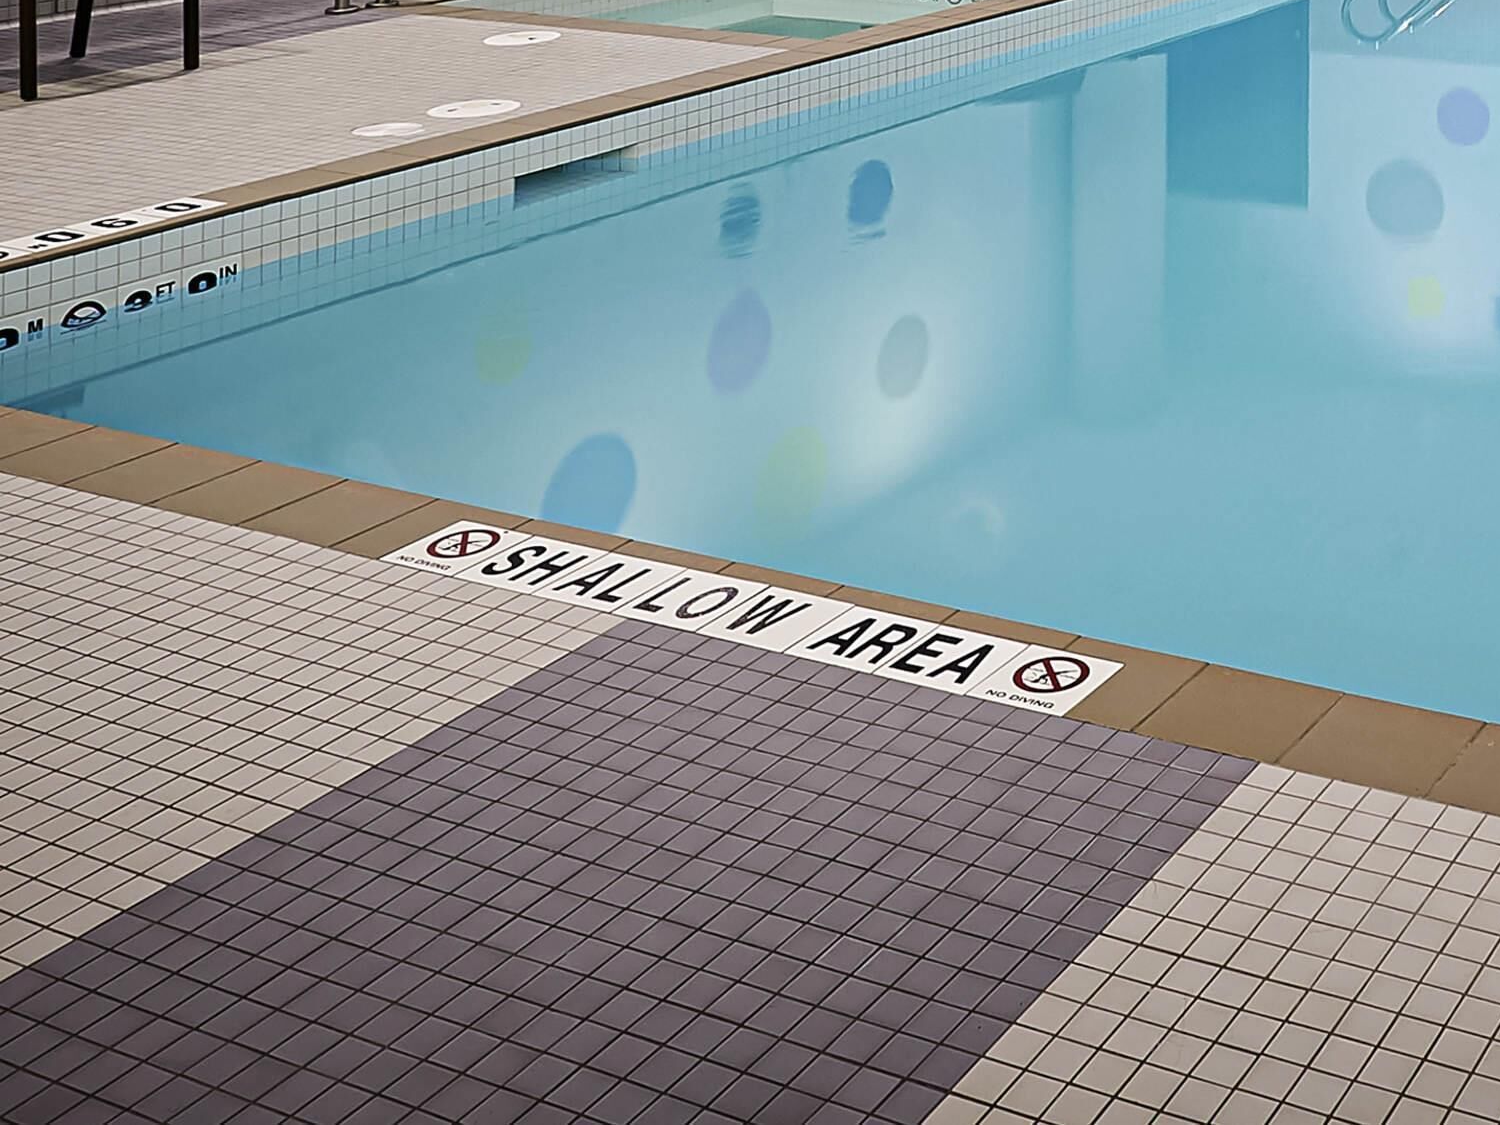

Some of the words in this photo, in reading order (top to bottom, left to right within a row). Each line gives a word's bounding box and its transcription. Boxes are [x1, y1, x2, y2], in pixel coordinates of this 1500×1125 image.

[220, 263, 238, 279] IN
[481, 545, 813, 635] SHALLOW
[806, 618, 996, 685] AREA
[985, 689, 1007, 698] NO
[1009, 694, 1054, 709] DIVING
